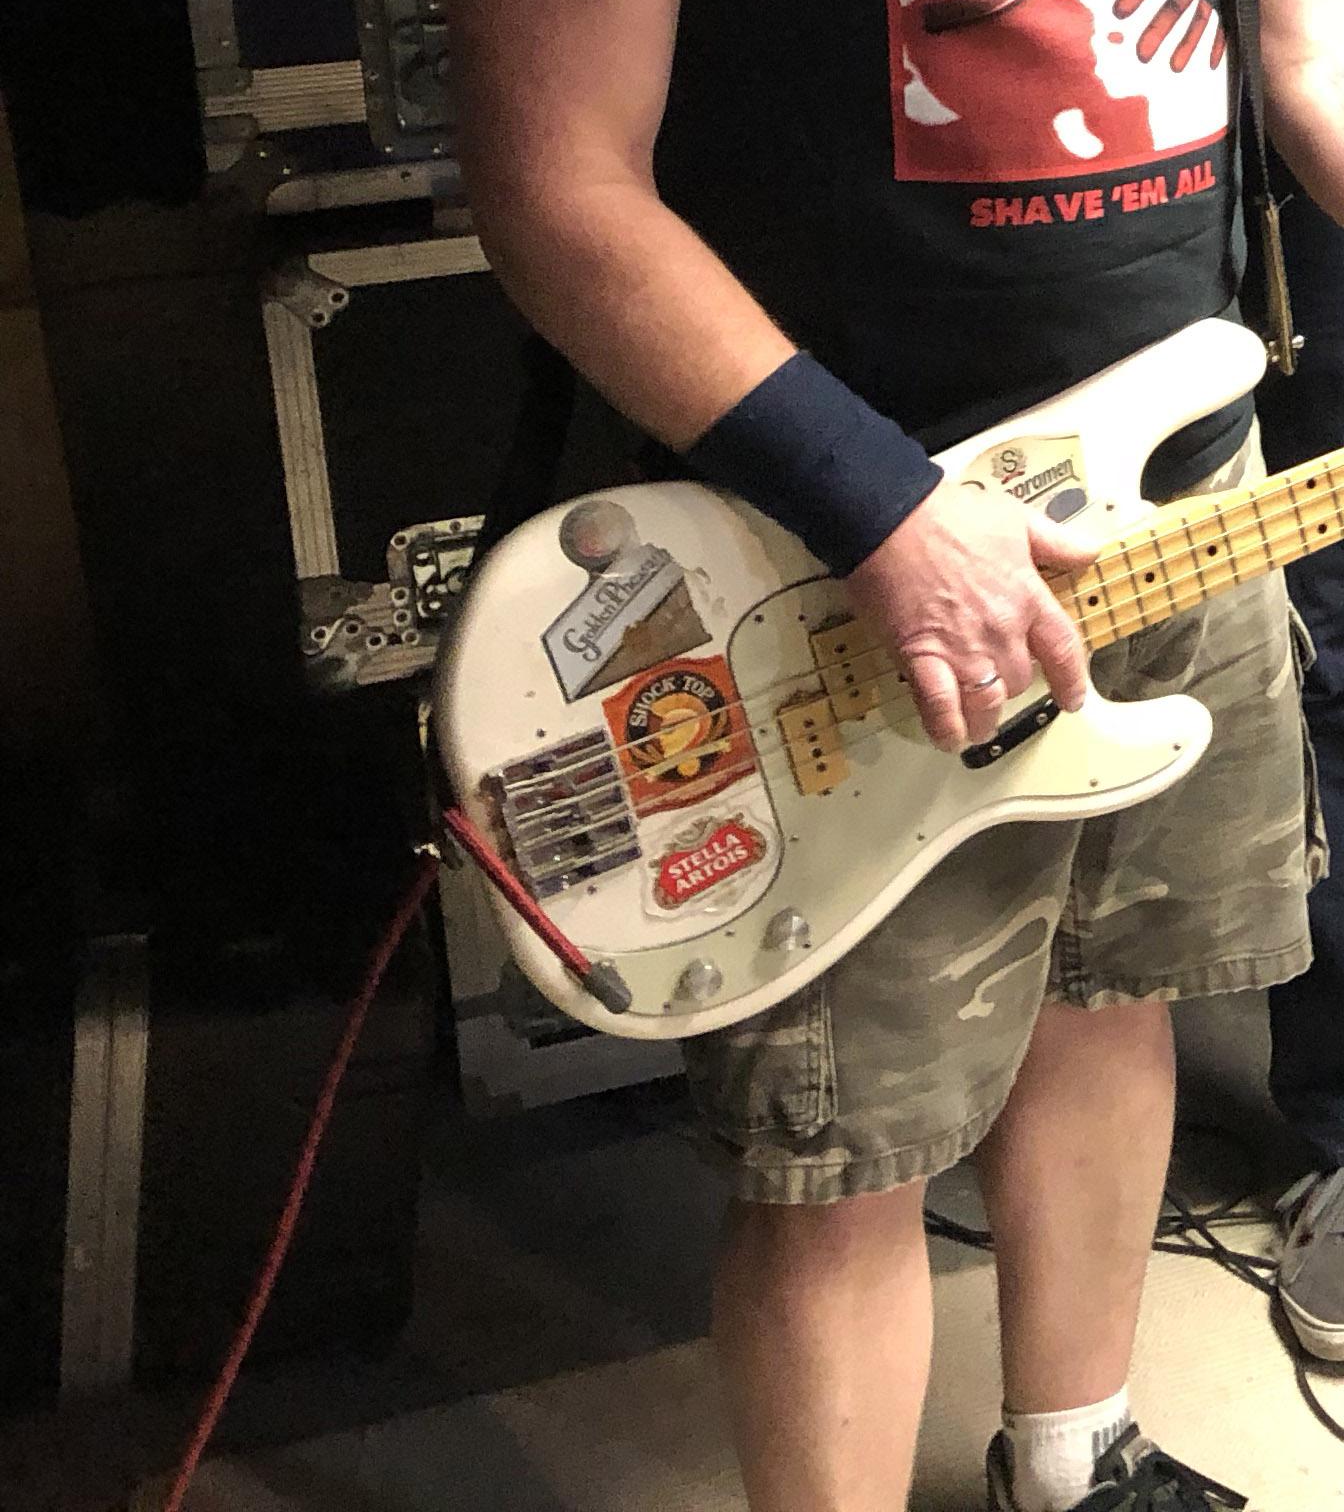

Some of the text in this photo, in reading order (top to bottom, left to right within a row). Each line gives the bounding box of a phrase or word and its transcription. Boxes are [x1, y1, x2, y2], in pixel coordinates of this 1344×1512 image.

[969, 160, 1217, 228] SHAVE 'EM ALL
[563, 600, 618, 662] Golden
[629, 675, 718, 728] SHOCK TOP
[667, 832, 741, 881] STELLA
[675, 846, 750, 894] ARTOIS
